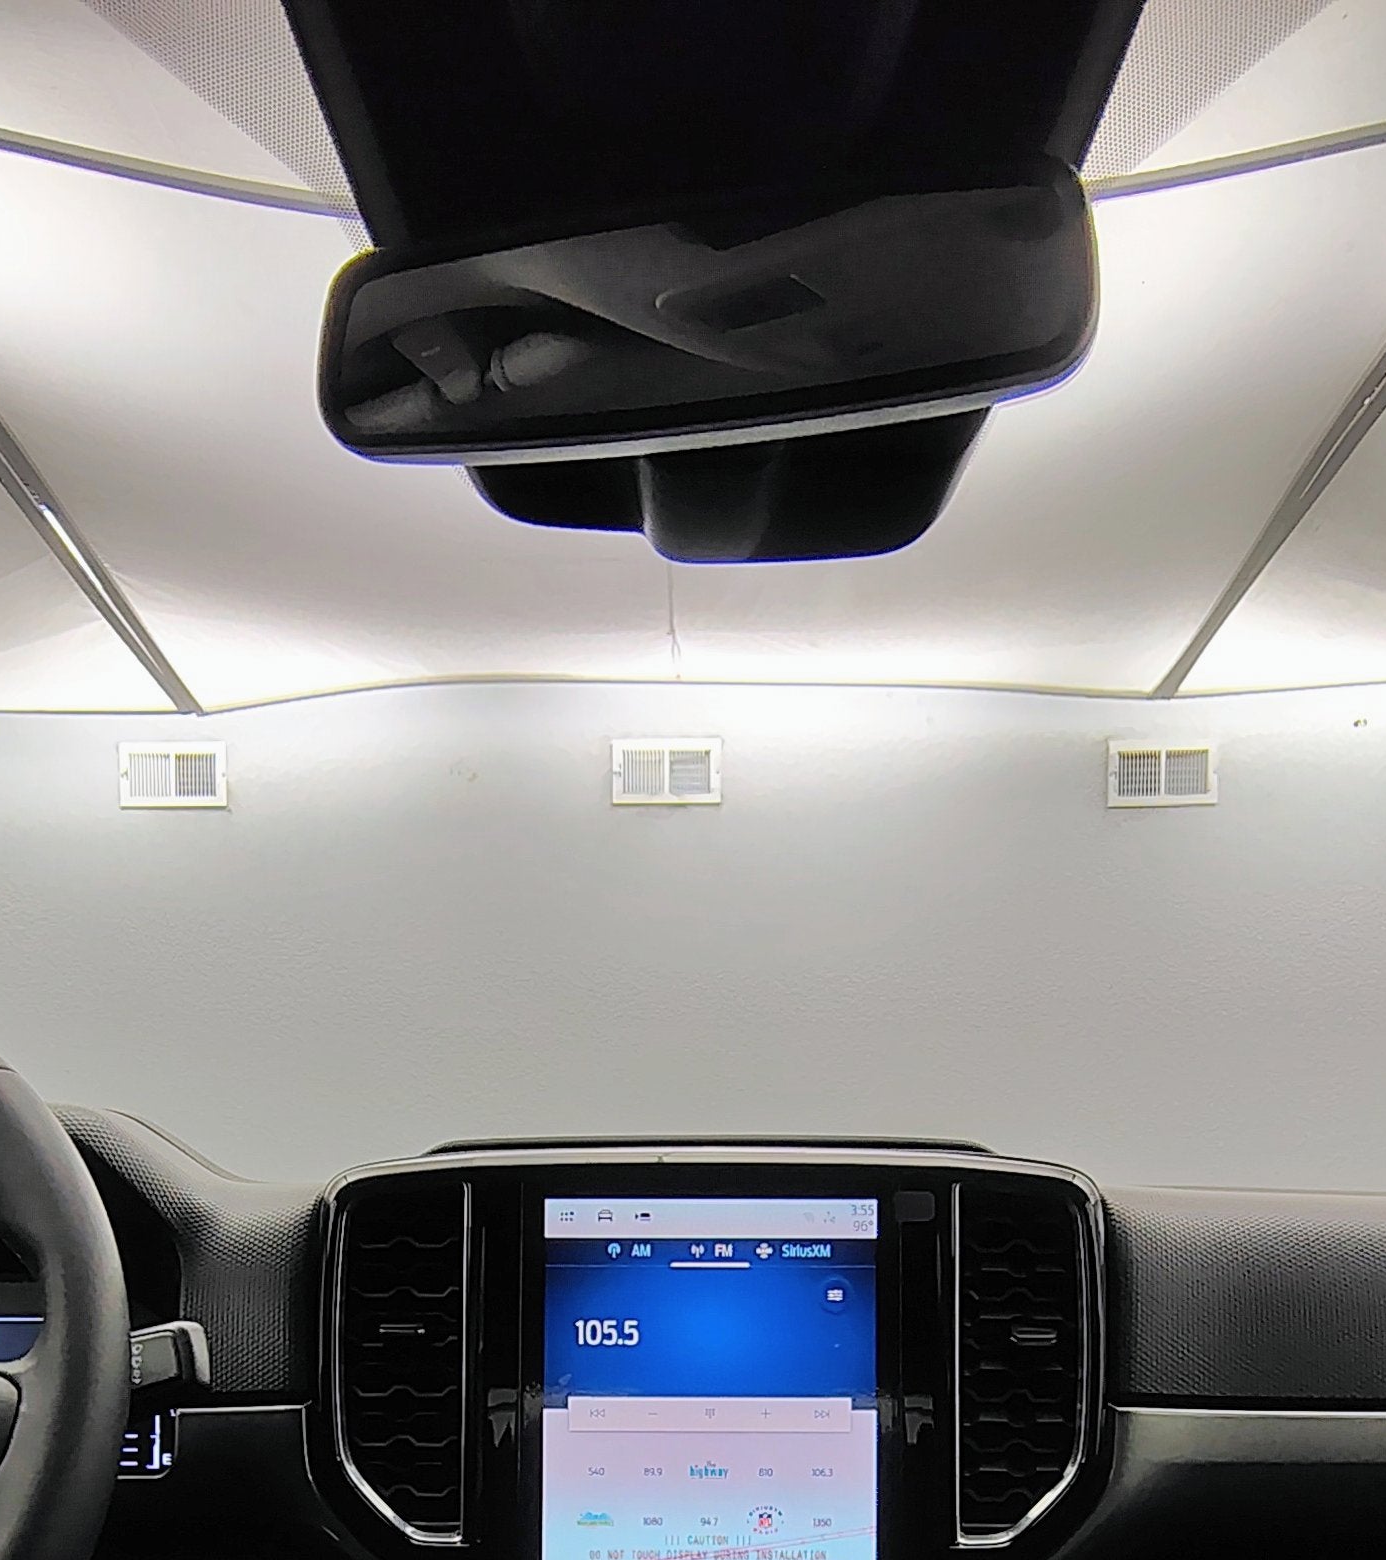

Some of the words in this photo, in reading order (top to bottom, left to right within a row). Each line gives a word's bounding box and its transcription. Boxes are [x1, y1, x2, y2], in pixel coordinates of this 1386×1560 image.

[631, 1244, 652, 1257] AM
[713, 1244, 734, 1258] FM
[781, 1243, 832, 1259] SiriusXM
[574, 1318, 640, 1347] 105.5
[687, 1535, 729, 1546] CAUTION
[756, 1549, 827, 1560] INSTALLATION
